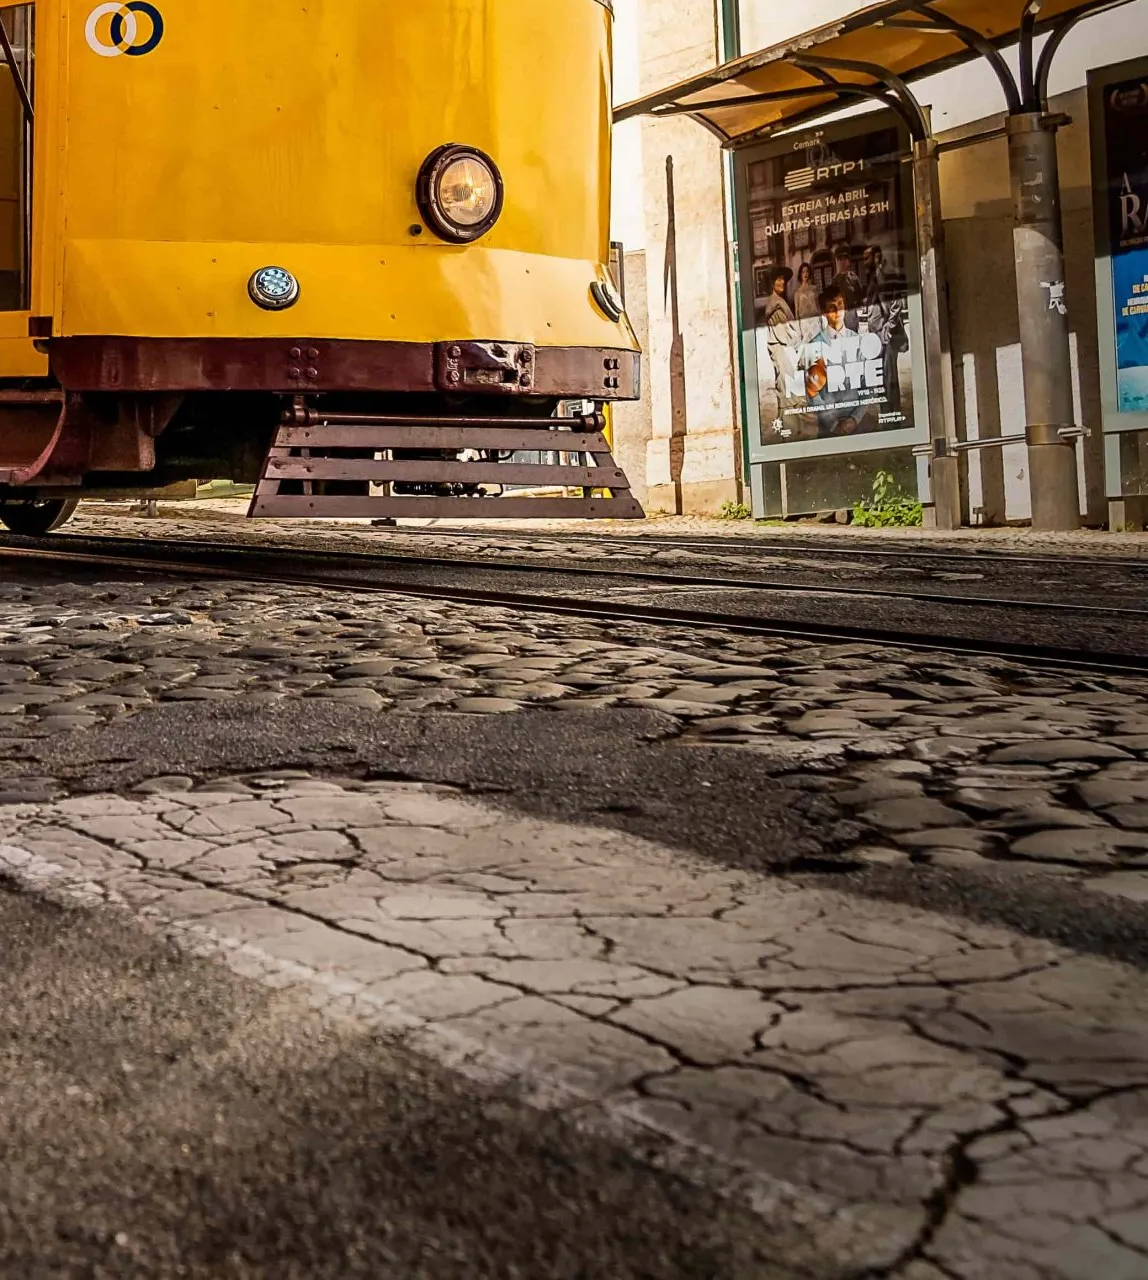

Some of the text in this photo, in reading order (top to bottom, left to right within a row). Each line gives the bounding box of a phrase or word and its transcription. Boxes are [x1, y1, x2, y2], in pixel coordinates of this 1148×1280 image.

[816, 158, 865, 181] RTP1
[1120, 172, 1132, 195] A
[781, 188, 869, 217] ESTREIA 14 ABRIL
[765, 209, 851, 237] QUARTAS-FEIRAS
[869, 201, 889, 215] 21H
[783, 332, 882, 377] VENTO
[784, 358, 884, 398] NORTE
